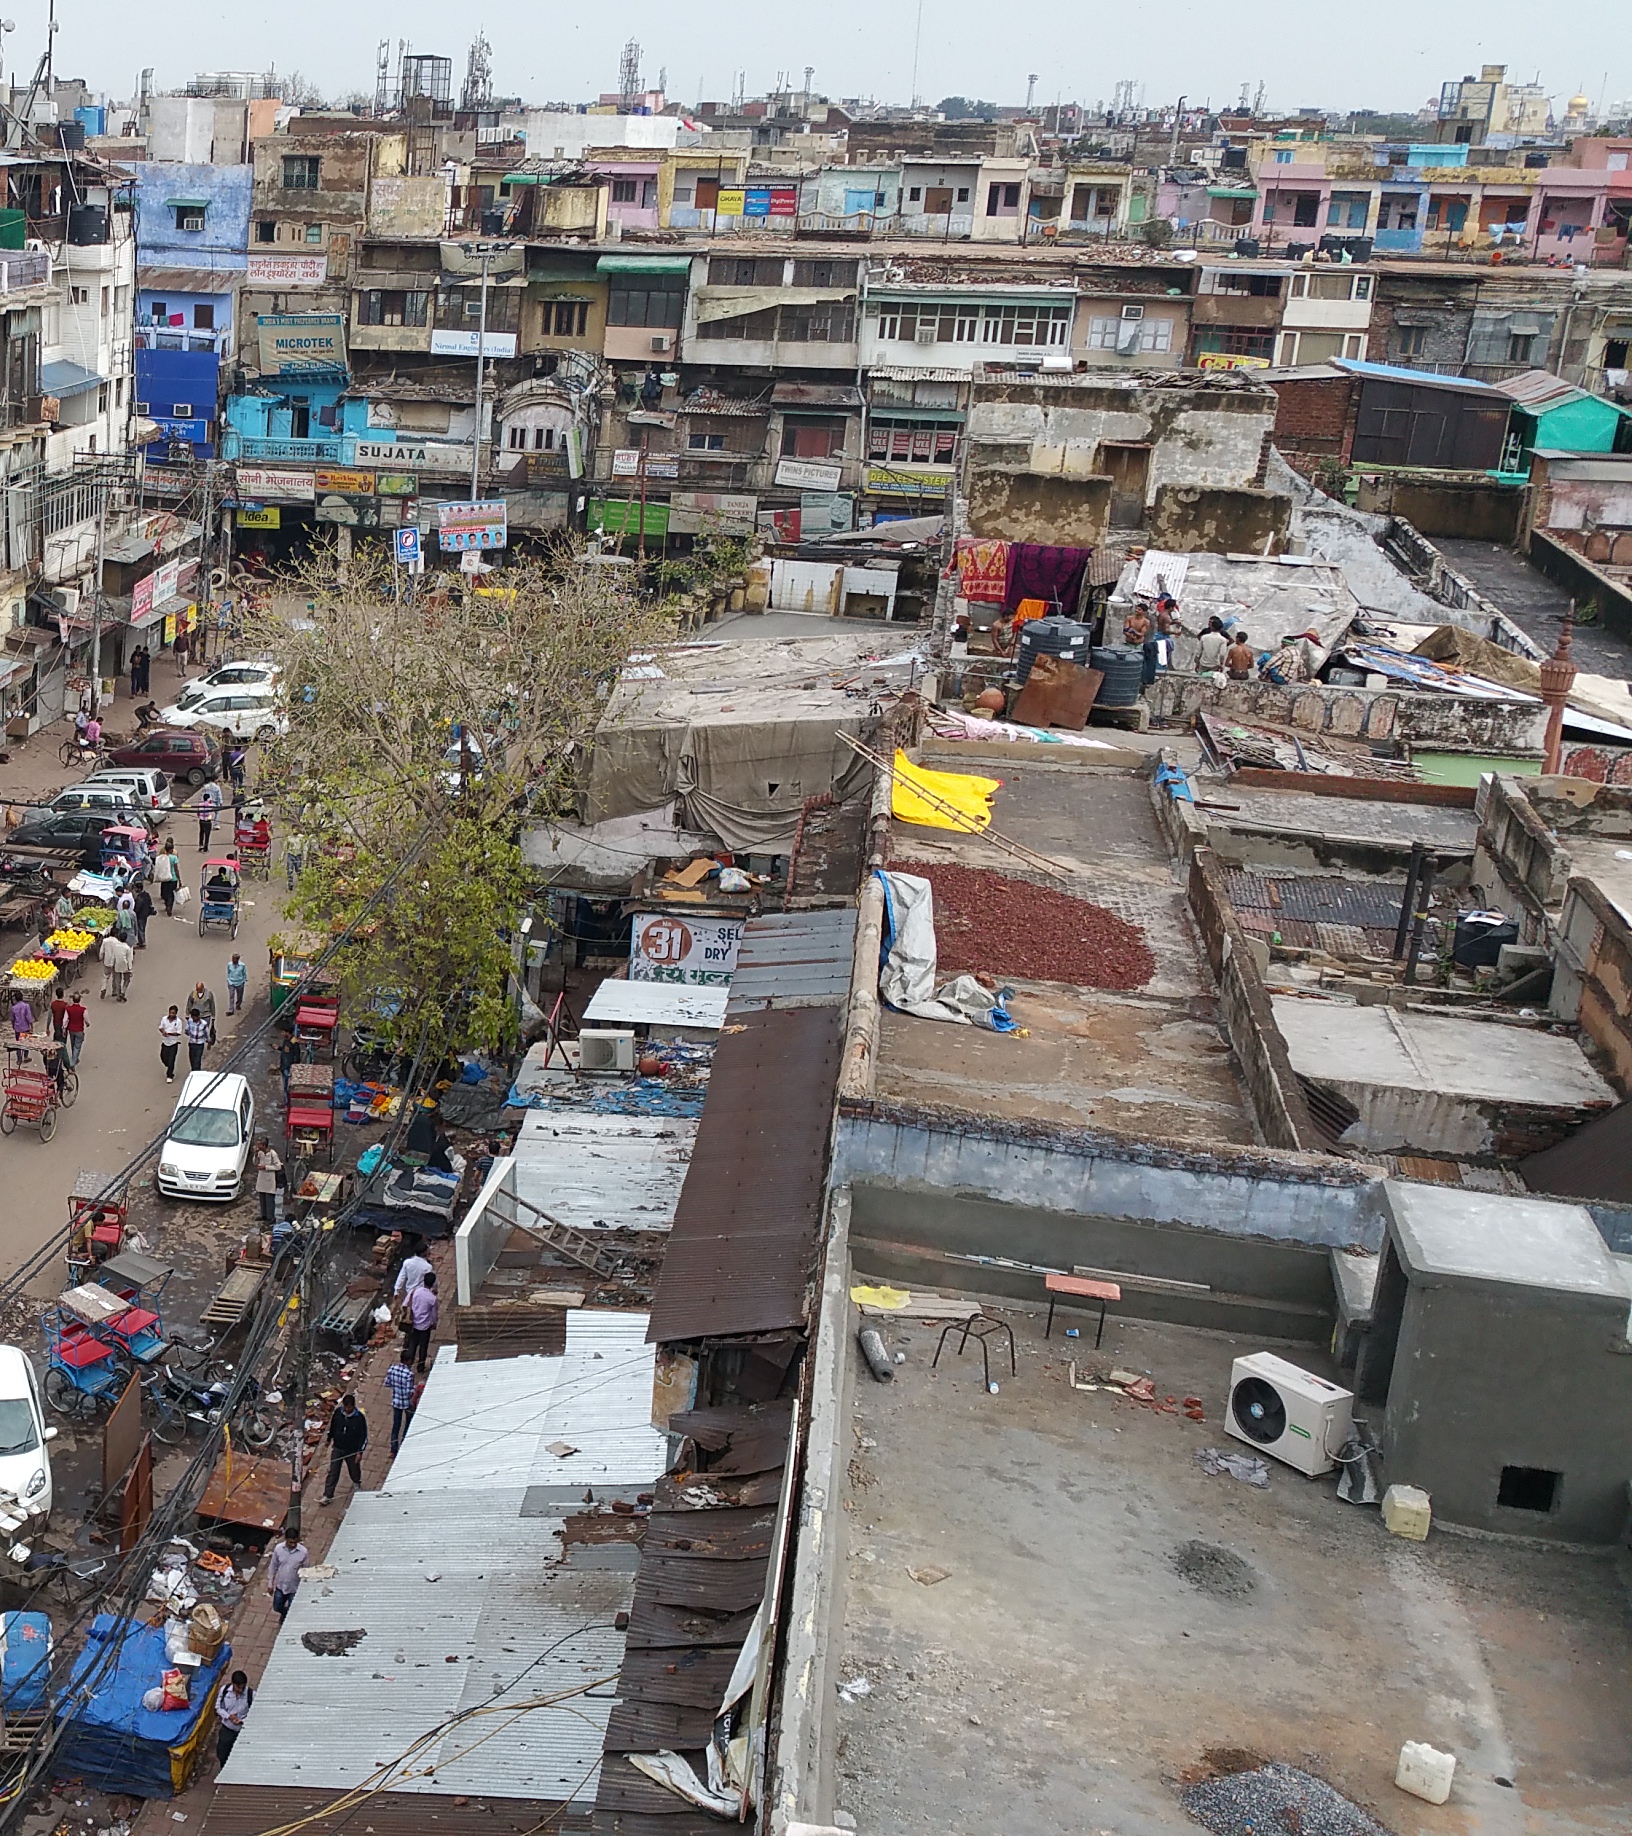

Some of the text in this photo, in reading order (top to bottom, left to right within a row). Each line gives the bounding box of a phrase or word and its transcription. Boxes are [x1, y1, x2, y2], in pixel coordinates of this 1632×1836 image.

[275, 338, 333, 349] MICROTEK
[491, 346, 513, 354] (India)
[359, 446, 426, 460] SUJATA
[781, 465, 838, 479] TWINS PICTURES
[870, 473, 888, 482] DEE
[239, 473, 313, 487] सोनी भोजनालय
[649, 927, 684, 961] 31
[705, 947, 729, 961] DRY
